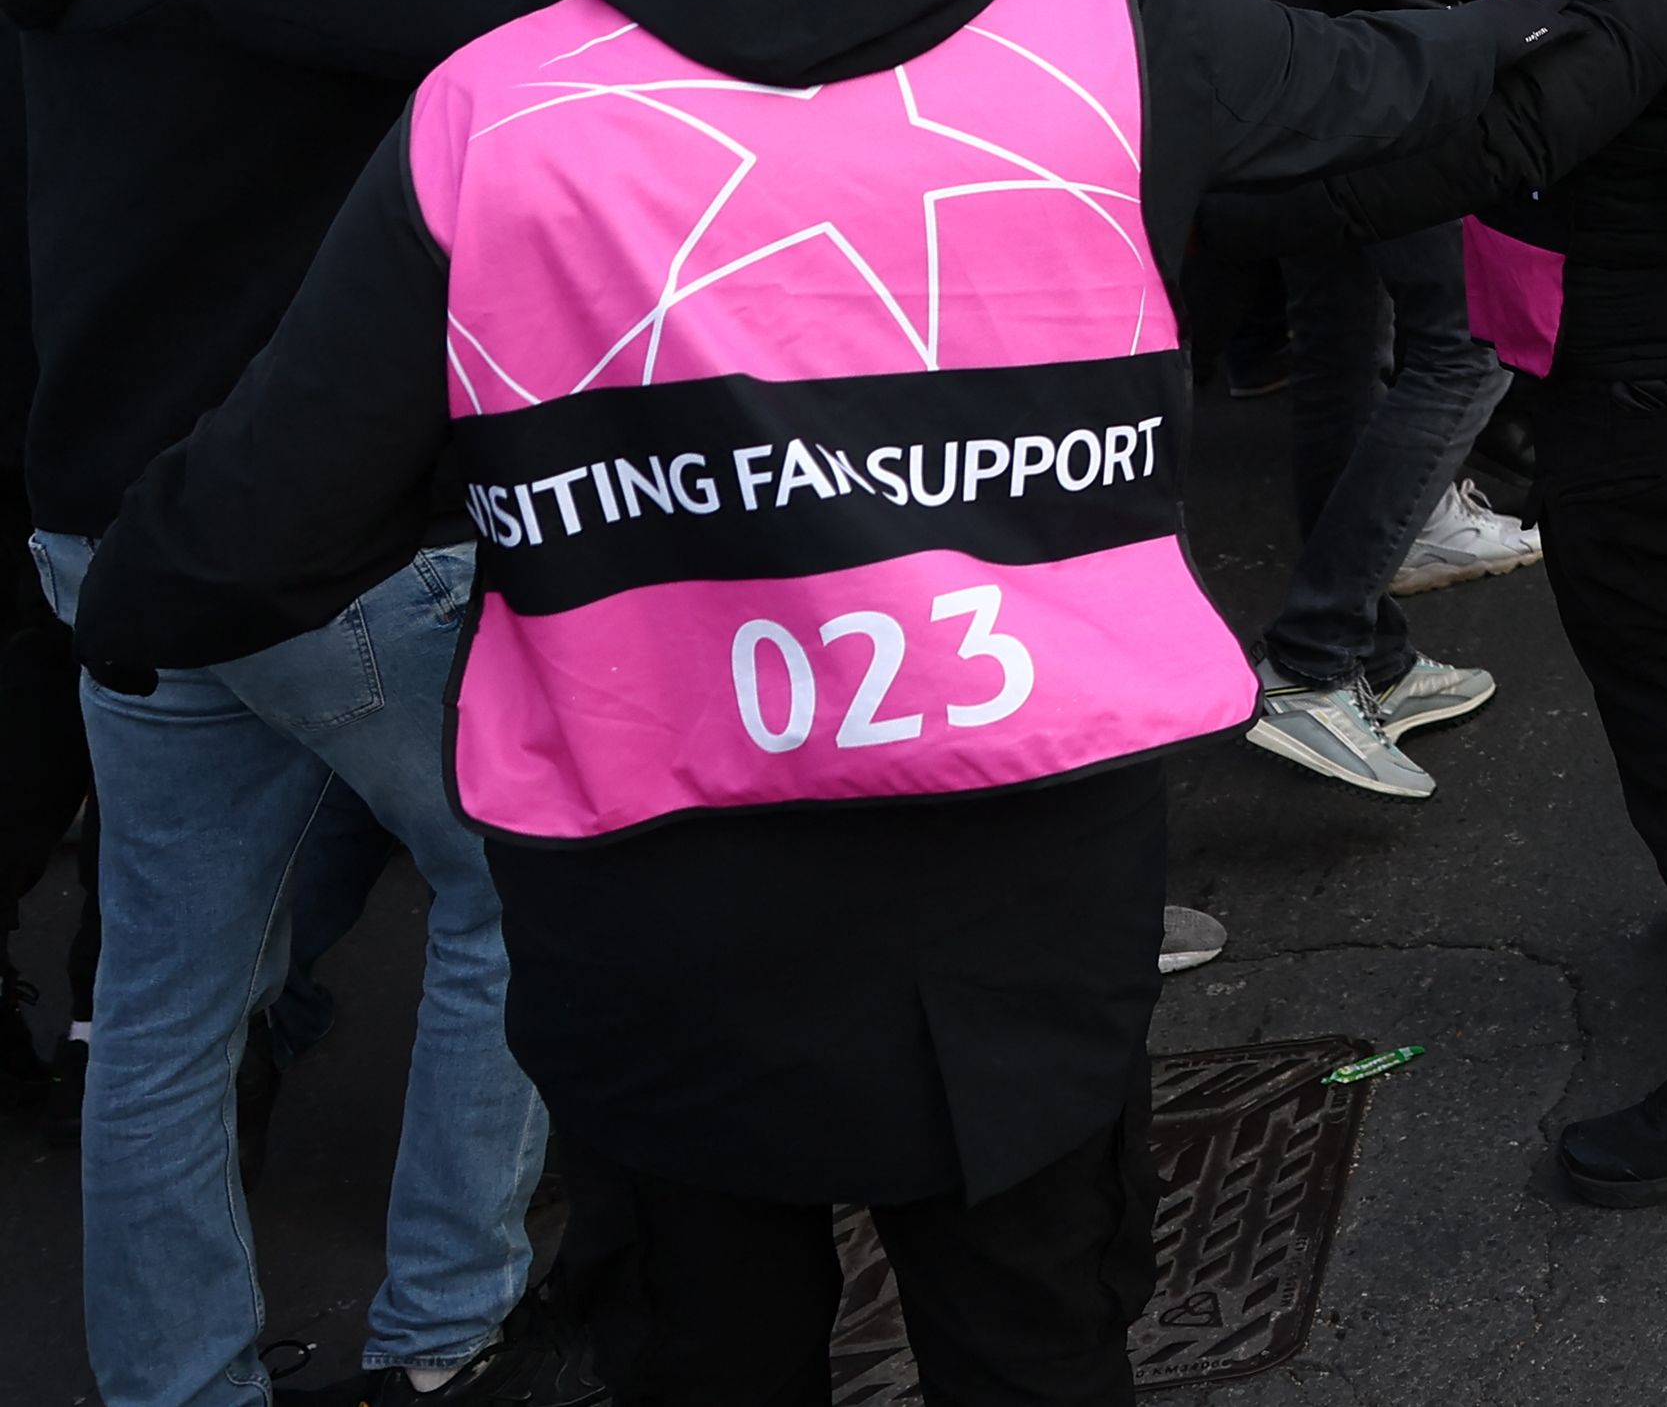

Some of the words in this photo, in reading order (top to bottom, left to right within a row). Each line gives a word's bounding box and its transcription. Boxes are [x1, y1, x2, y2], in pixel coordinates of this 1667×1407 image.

[465, 452, 715, 548] VISITING
[866, 416, 1163, 507] SUPPORT
[730, 584, 1035, 754] 023
